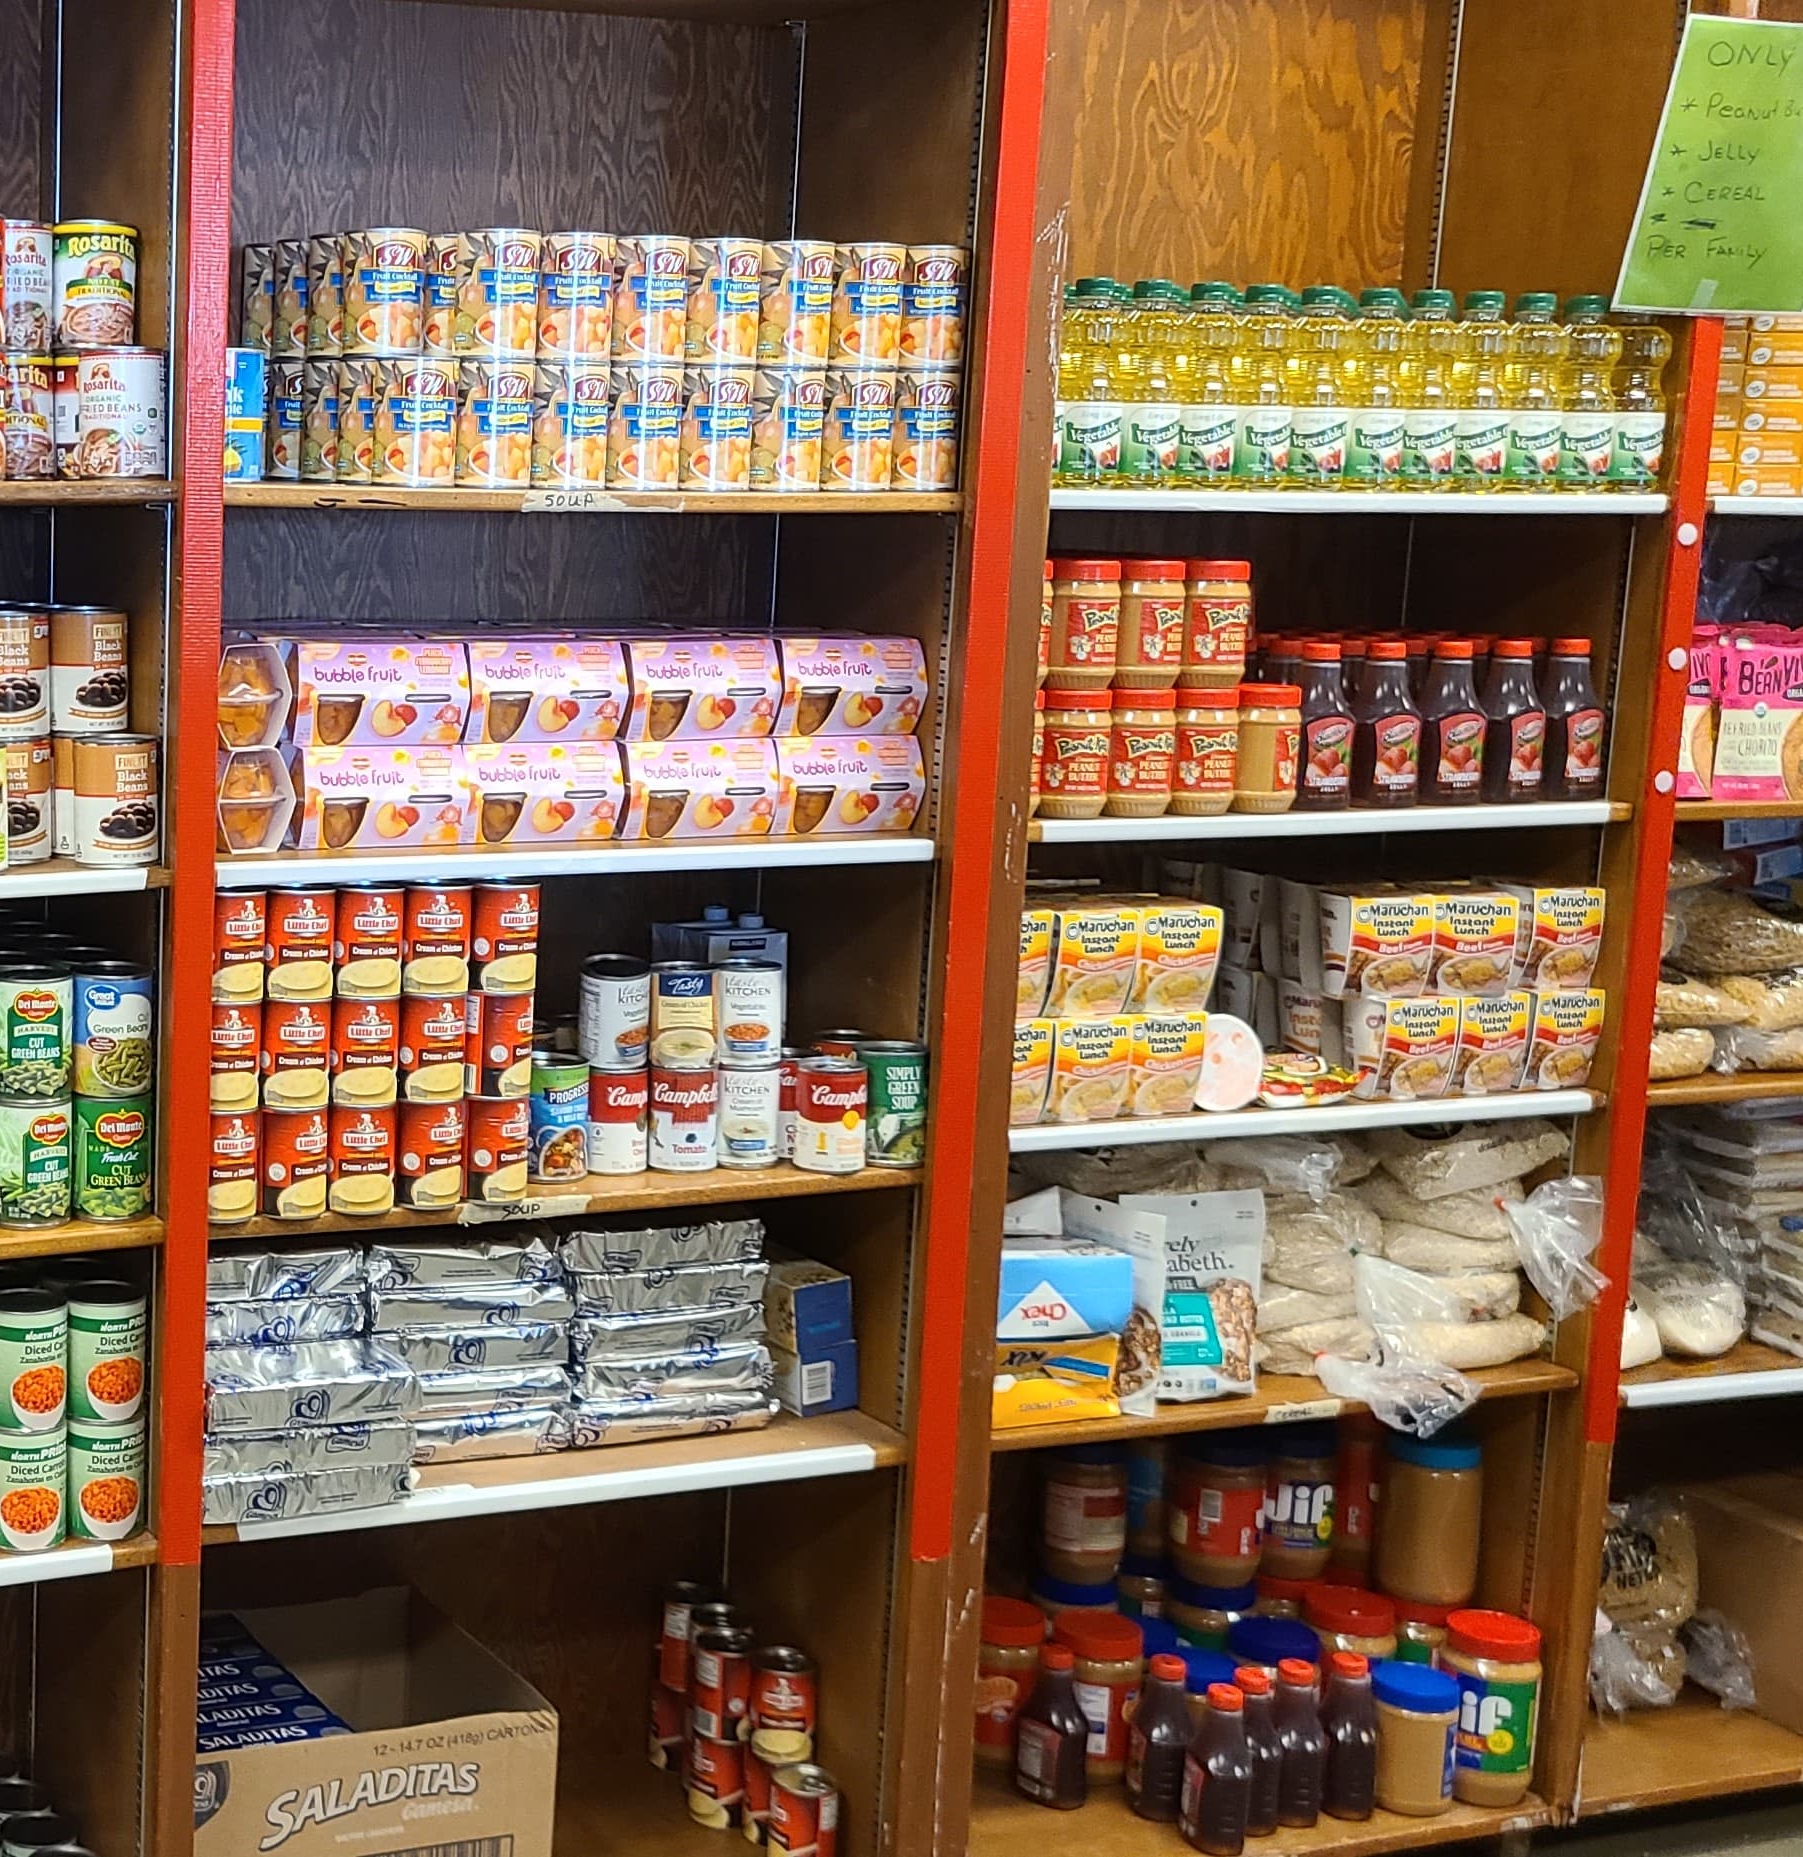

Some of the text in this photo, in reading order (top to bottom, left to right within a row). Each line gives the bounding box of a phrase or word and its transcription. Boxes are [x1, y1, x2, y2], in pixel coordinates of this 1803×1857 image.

[1708, 40, 1795, 78] ONLY
[1706, 92, 1776, 120] Peanut
[1698, 140, 1760, 168] JELLY
[1684, 181, 1766, 204] CEREAL
[68, 236, 135, 257] Rosarita
[1647, 234, 1686, 259] PER
[106, 404, 142, 413] BEANS
[314, 666, 402, 684] bubble fruit
[1068, 762, 1101, 772] PEANUT
[1445, 903, 1512, 917] Maruchan
[287, 919, 309, 931] Little
[1158, 917, 1215, 929] Maruchan
[1450, 917, 1495, 928] Instant
[1161, 931, 1200, 940] Instant
[1454, 925, 1489, 936] Lunch
[1164, 940, 1195, 949] Lunch
[1455, 941, 1481, 952] Beef
[88, 990, 115, 1002] Great
[725, 985, 771, 996] KITCHEN
[14, 1024, 57, 1036] HARVEST
[93, 1023, 123, 1034] Green
[28, 1037, 46, 1049] CUT
[12, 1046, 60, 1059] GREEN BEANS
[886, 1066, 922, 1080] SIMPLY
[888, 1081, 920, 1094] GREEN
[891, 1096, 917, 1110] SOUP
[672, 1144, 706, 1154] Tomato
[502, 1203, 540, 1217] SOUP
[1020, 1303, 1067, 1320] Chex
[11, 1450, 39, 1461] NORTH
[11, 1464, 38, 1476] Diced
[1264, 1484, 1333, 1523] Jif
[199, 1725, 308, 1750] SALADITAS
[373, 1744, 388, 1758] 12
[400, 1740, 423, 1754] 14.7
[427, 1738, 445, 1750] OZ
[258, 1761, 480, 1852] SALADITAS
